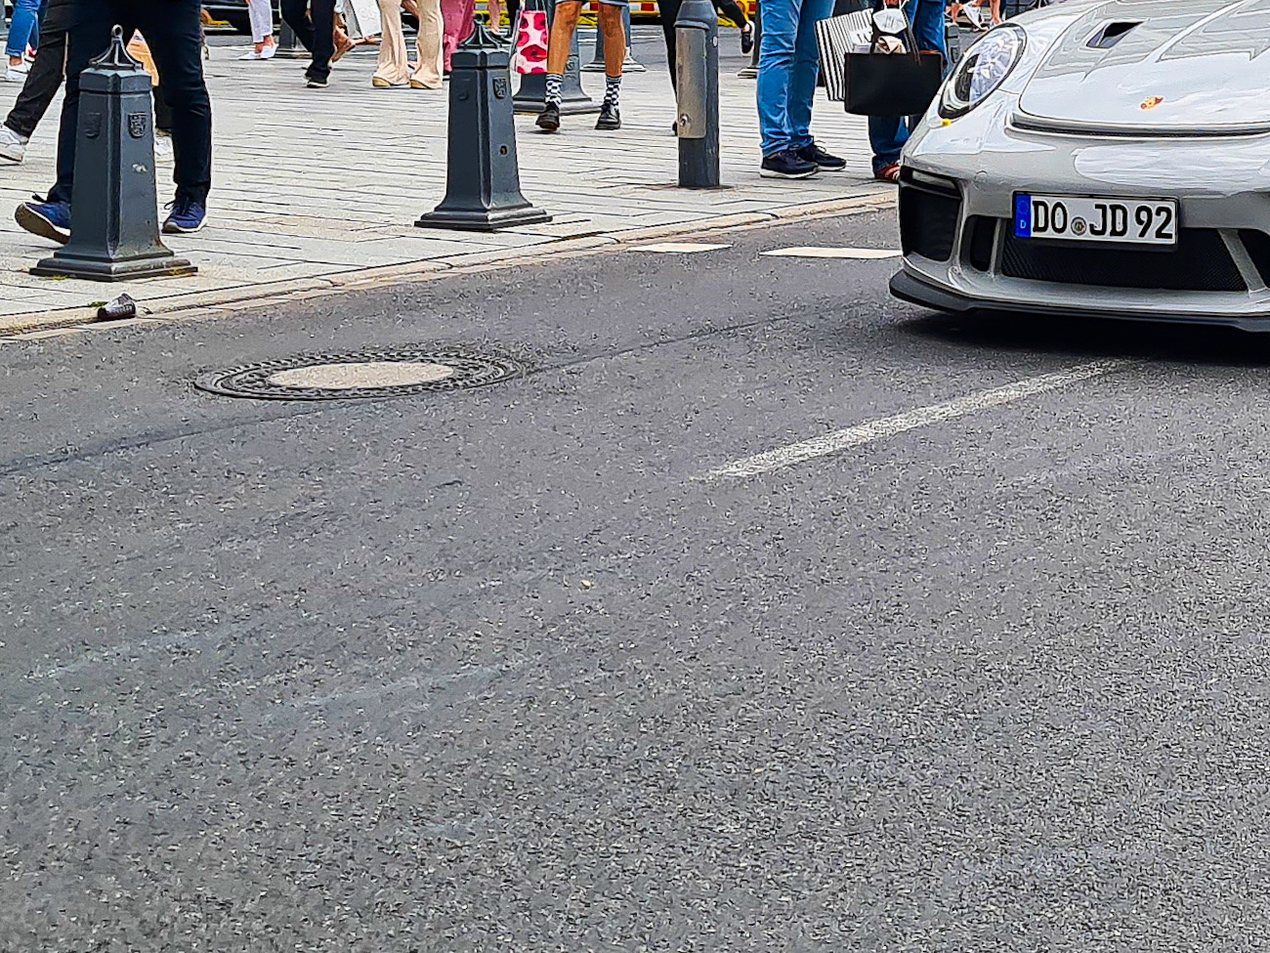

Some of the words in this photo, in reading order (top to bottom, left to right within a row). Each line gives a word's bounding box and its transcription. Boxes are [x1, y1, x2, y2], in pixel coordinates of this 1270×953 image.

[1032, 200, 1068, 234] DO
[1089, 203, 1128, 237] JD
[1134, 205, 1173, 240] 92
